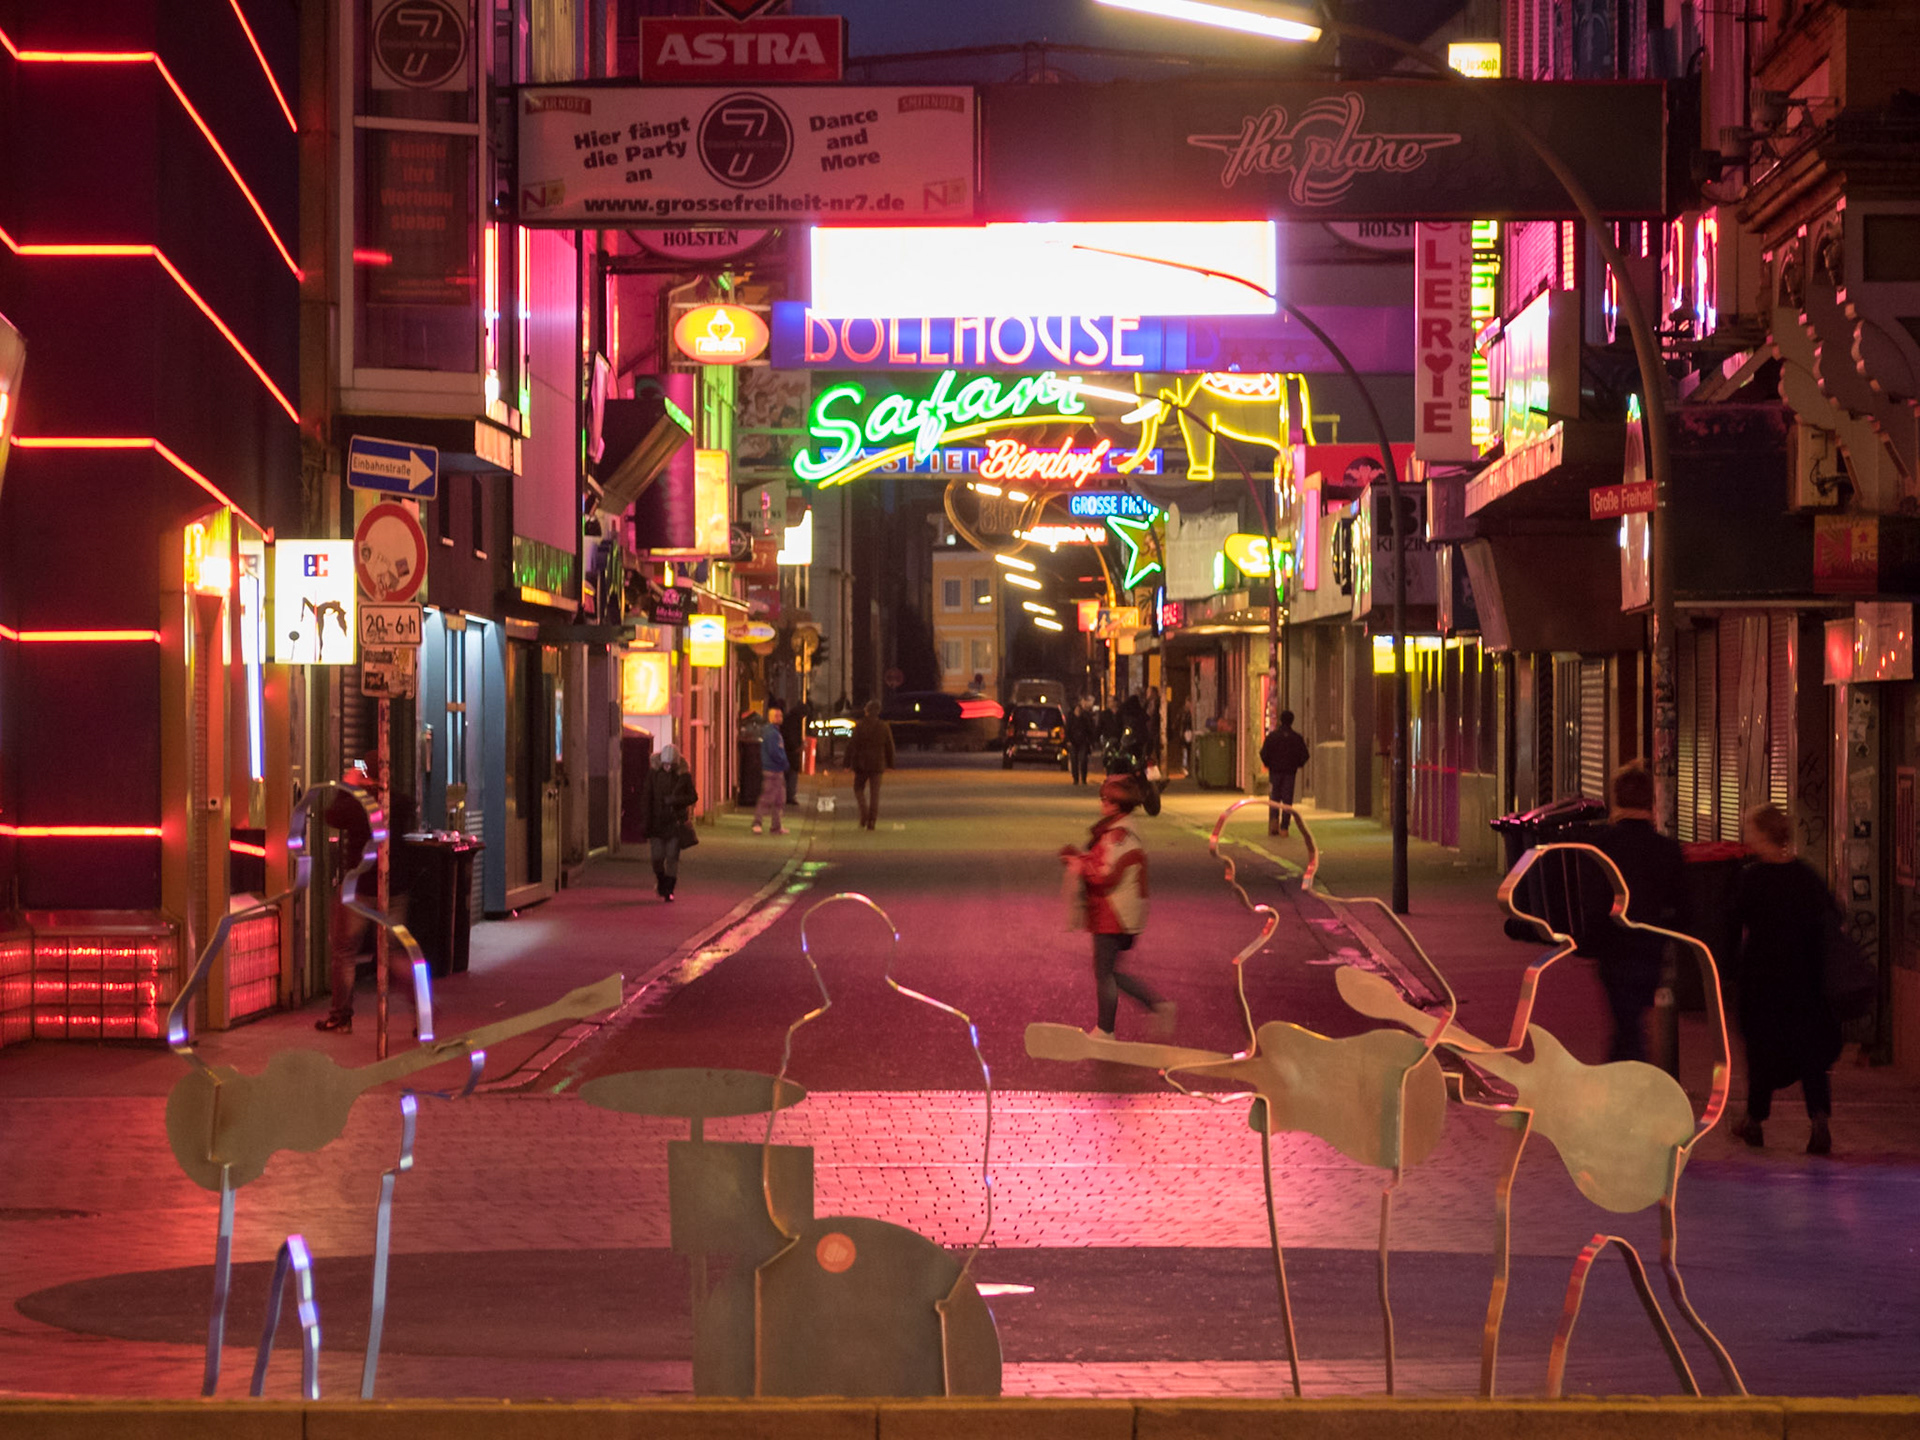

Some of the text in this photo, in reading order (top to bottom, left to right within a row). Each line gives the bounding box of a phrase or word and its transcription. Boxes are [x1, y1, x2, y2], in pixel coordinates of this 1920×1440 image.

[656, 32, 826, 65] ASTRA
[809, 108, 879, 132] Dance
[573, 117, 691, 150] Hier fängt
[826, 128, 869, 150] and
[583, 151, 619, 169] die
[624, 140, 687, 162] Party
[1223, 95, 1421, 201] the plane
[820, 151, 881, 172] More
[625, 168, 653, 183] an
[584, 193, 905, 216] www.grossefreiheit-nr7.de
[663, 231, 739, 247] HOLSTEN
[1358, 222, 1411, 237] HOLST
[1458, 255, 1470, 329] NIGHT
[805, 312, 1144, 367] DOLLHOUSE
[1458, 338, 1470, 354] &
[1458, 363, 1470, 410] BAR
[793, 370, 1086, 480] Safari
[353, 456, 411, 476] Einbahnstraße
[980, 436, 1111, 488] Bierdorf
[1072, 495, 1118, 515] GROSSE
[1593, 485, 1653, 512] Große Freiheit
